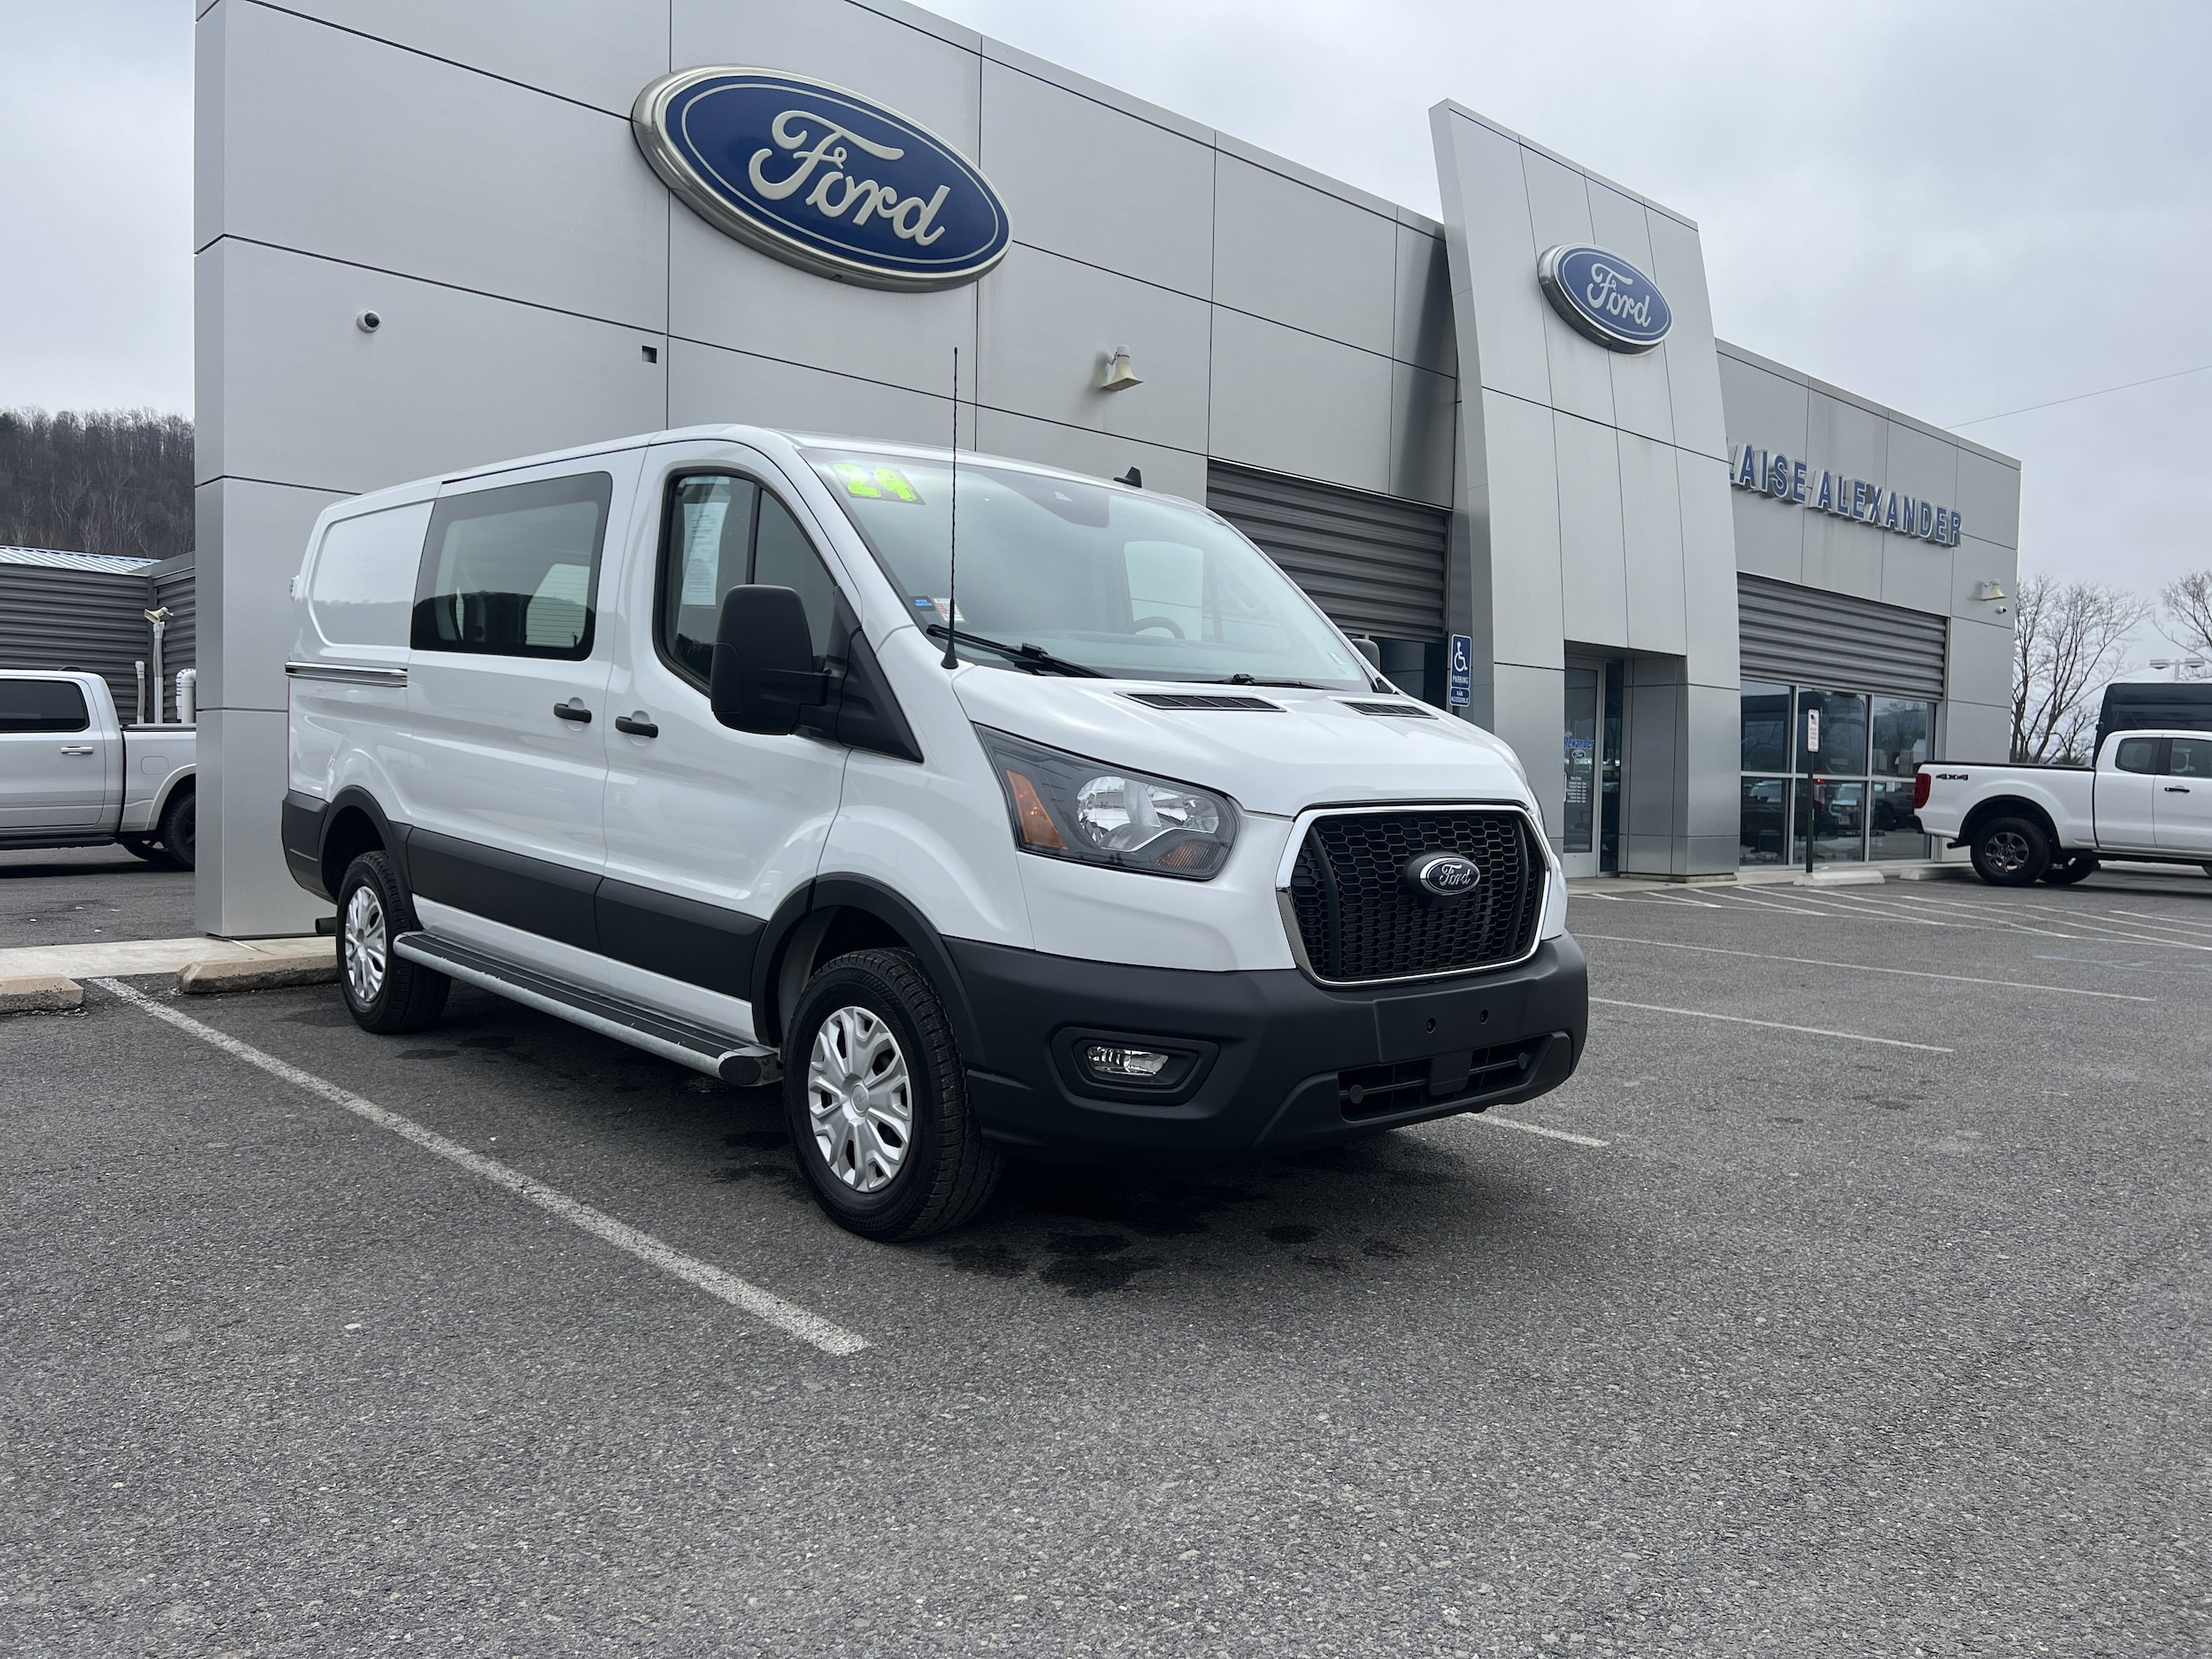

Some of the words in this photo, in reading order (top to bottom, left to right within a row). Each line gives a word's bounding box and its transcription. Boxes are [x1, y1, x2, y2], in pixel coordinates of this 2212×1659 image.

[749, 110, 951, 246] Ford
[1586, 263, 1652, 327] Ford
[833, 463, 918, 502] 24
[1729, 443, 1808, 504] AISE
[1816, 467, 1962, 547] ALEXANDER
[1452, 675, 1469, 685] PARKING
[1439, 864, 1471, 886] Ford
